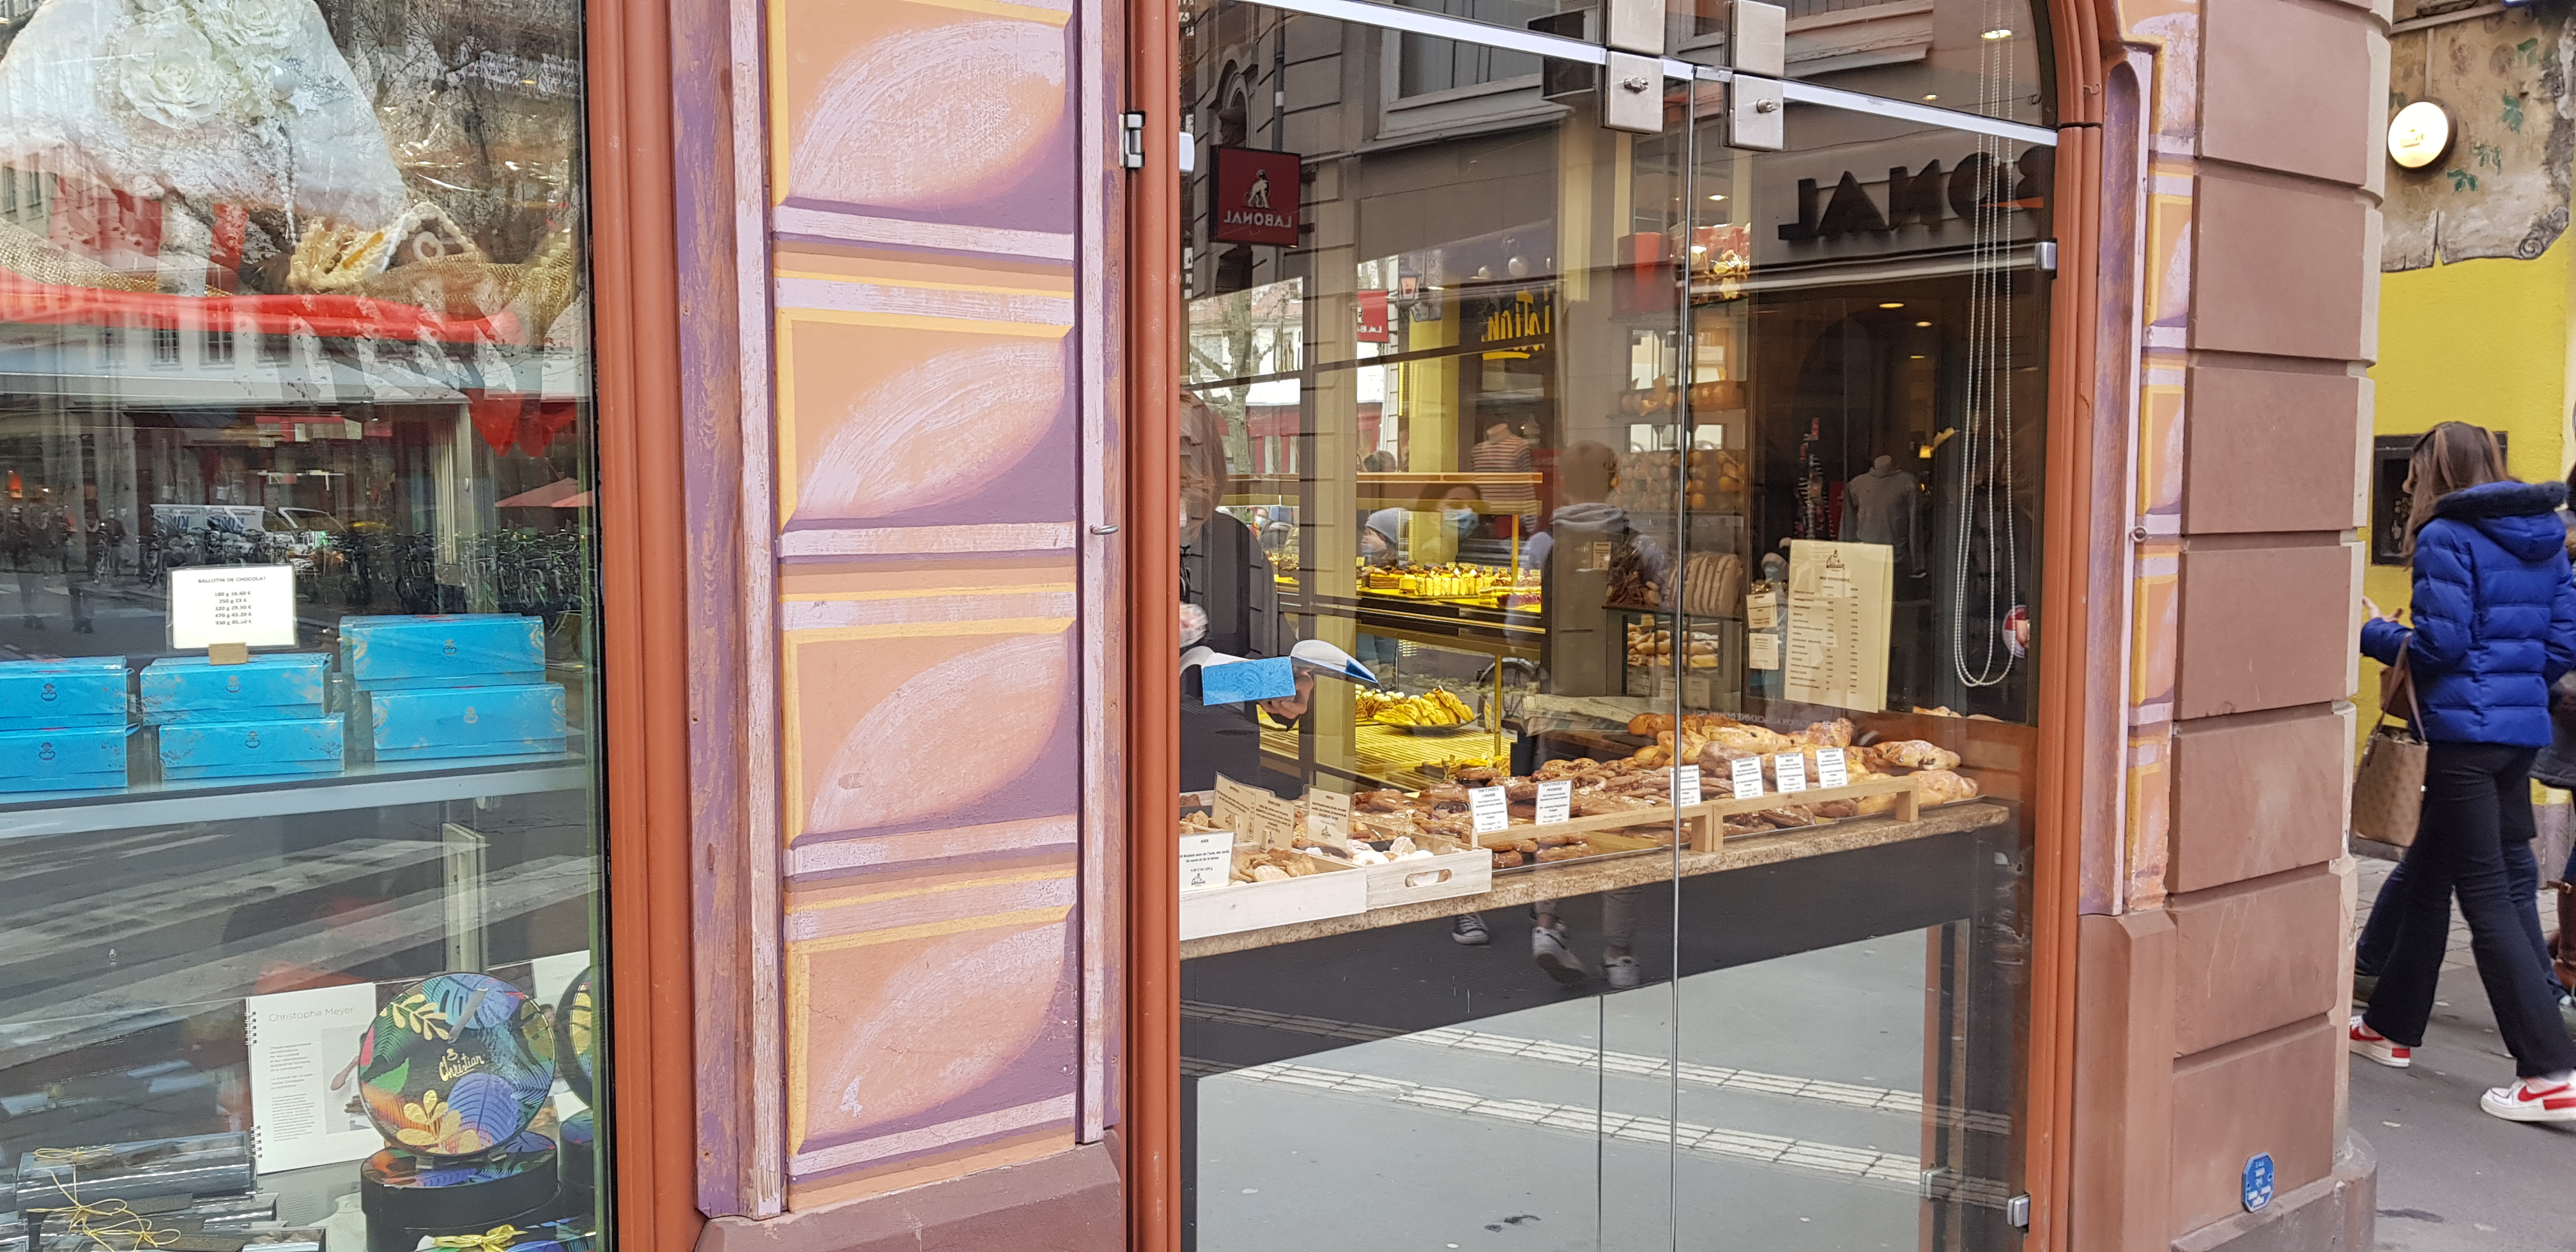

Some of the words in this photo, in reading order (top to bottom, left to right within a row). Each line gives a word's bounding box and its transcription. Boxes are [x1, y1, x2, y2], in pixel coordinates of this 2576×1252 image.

[269, 1011, 322, 1022] Christophe
[325, 1007, 353, 1016] Meyer
[439, 1053, 485, 1081] Christian
